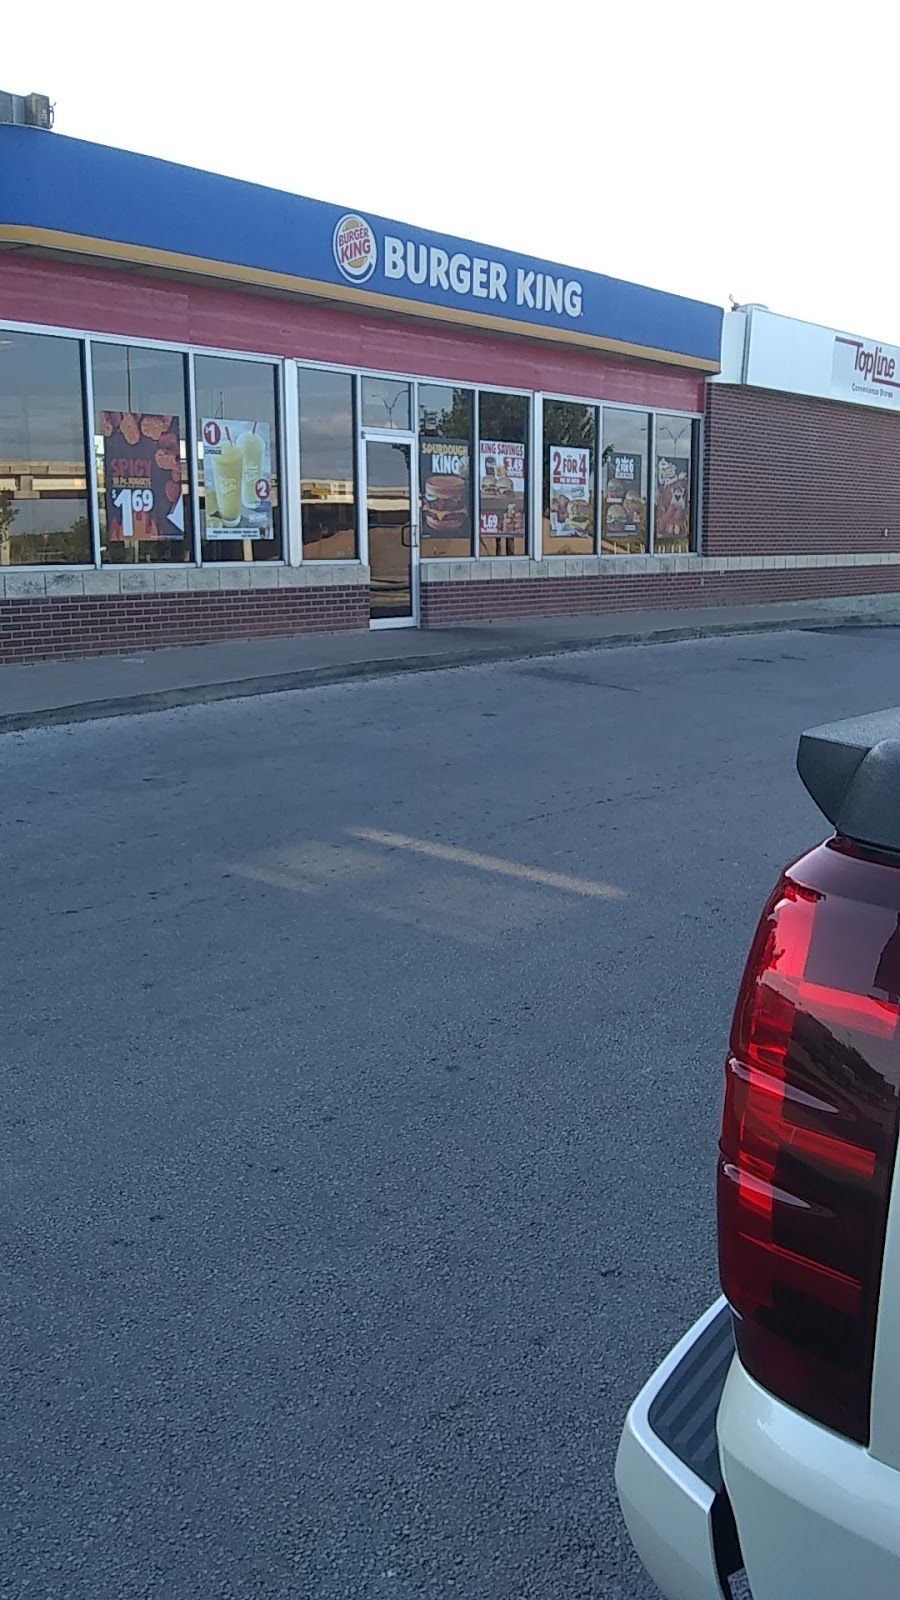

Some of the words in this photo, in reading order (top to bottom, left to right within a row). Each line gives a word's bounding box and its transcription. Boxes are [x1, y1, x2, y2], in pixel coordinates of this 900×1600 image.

[338, 227, 369, 246] BURGER
[340, 239, 371, 264] KING
[384, 235, 508, 303] BURGER
[516, 267, 583, 318] KING
[852, 383, 879, 396] Convenience
[880, 387, 893, 399] Stores
[422, 443, 468, 456] SOURDOUGH
[480, 442, 496, 455] KING
[497, 443, 524, 457] SAVINGS
[111, 458, 152, 477] SPICY
[432, 455, 460, 474] KING
[553, 451, 561, 476] 2
[563, 458, 578, 474] FOR
